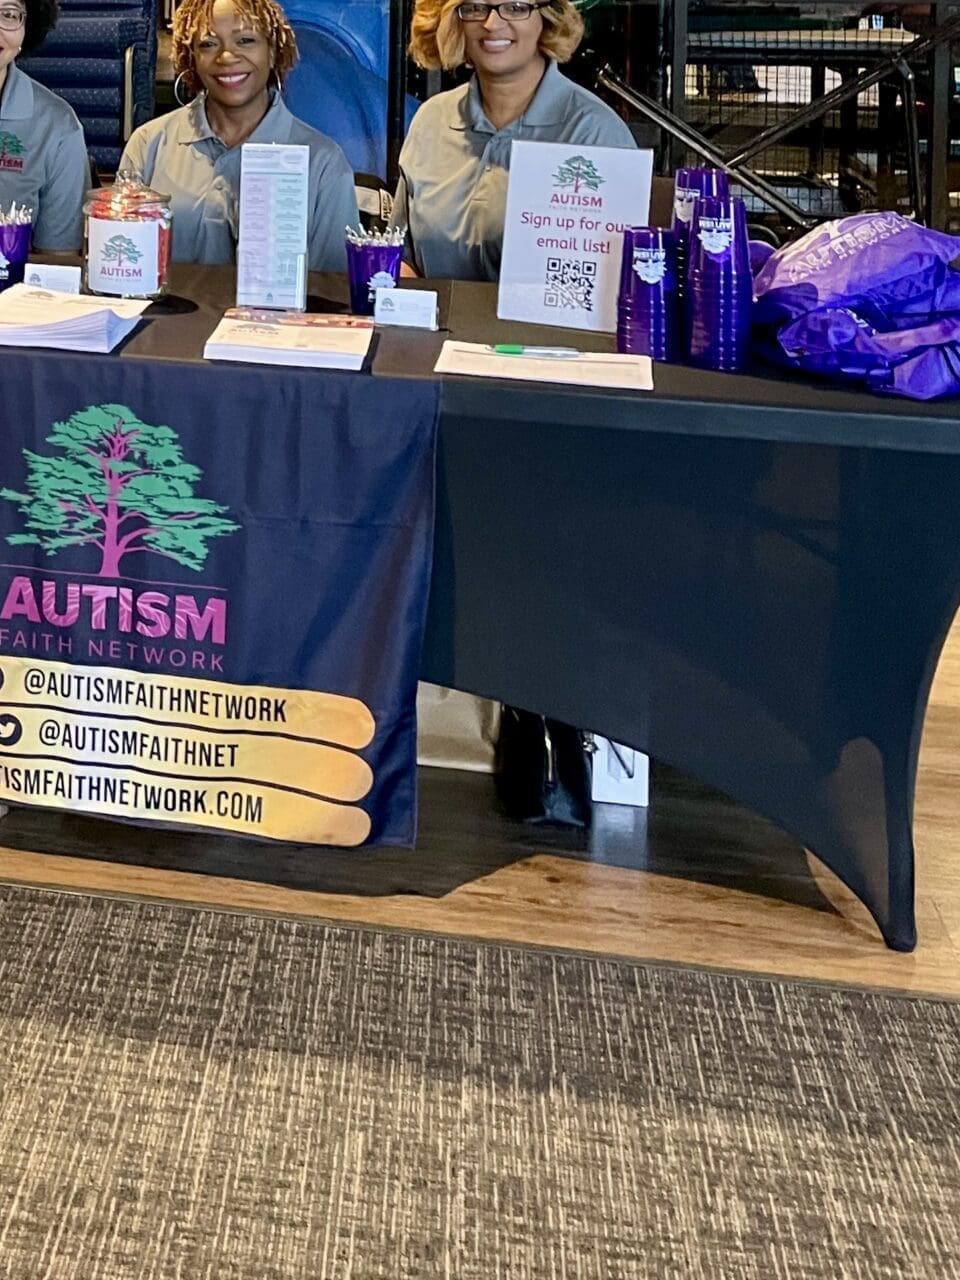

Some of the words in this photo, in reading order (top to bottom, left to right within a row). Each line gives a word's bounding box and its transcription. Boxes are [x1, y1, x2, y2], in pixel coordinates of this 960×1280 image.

[550, 193, 603, 208] AUTISM
[520, 211, 551, 229] Sign
[556, 217, 575, 231] up
[579, 216, 602, 231] for
[536, 236, 578, 251] email
[583, 239, 611, 254] list!
[100, 267, 143, 278] AUTISM
[0, 576, 228, 645] AUTISM
[88, 639, 225, 673] NETWORK
[23, 667, 288, 723] @AUTISMFAITHNETWORK
[38, 718, 240, 768] @AUTISMFAITHNET
